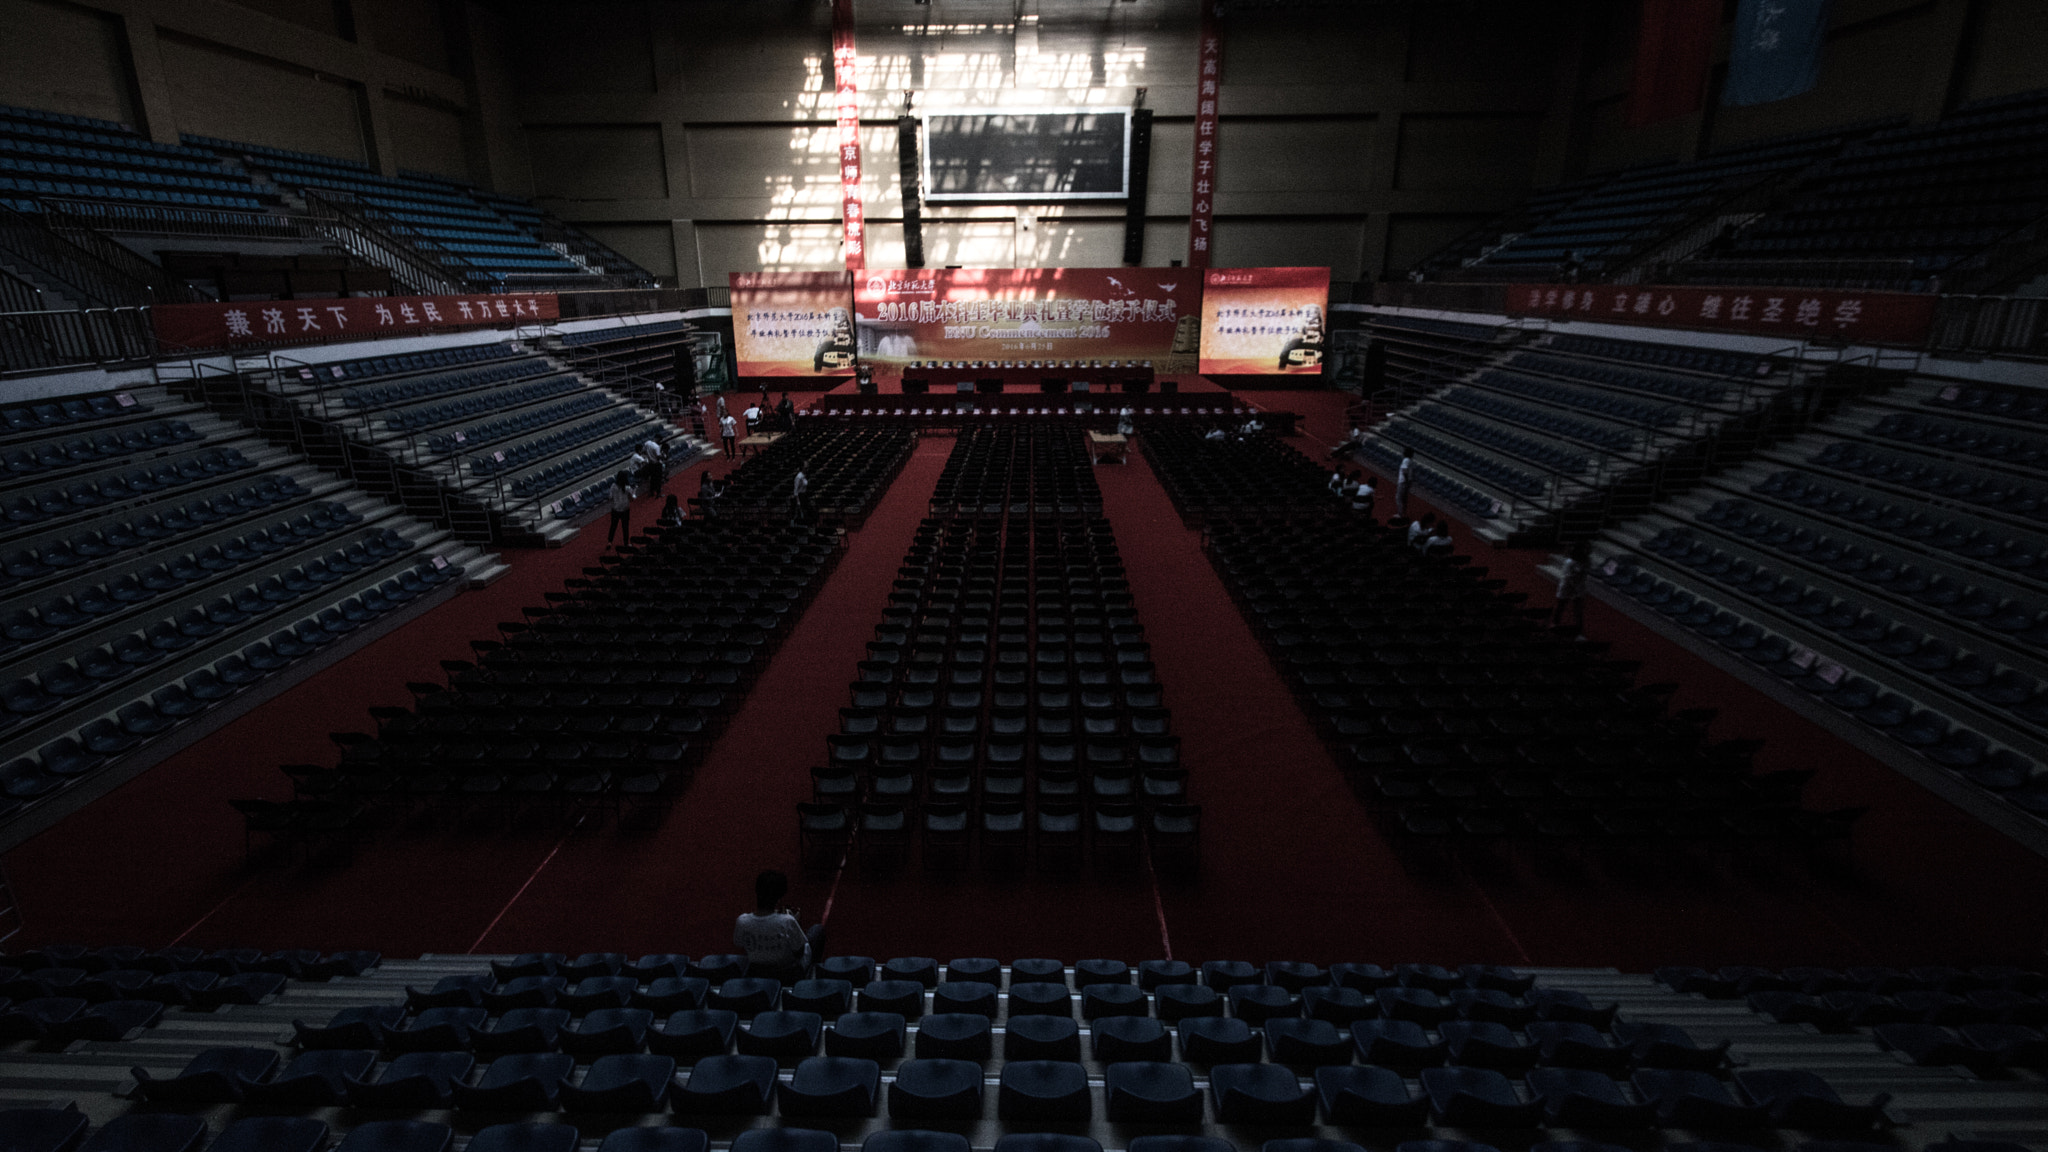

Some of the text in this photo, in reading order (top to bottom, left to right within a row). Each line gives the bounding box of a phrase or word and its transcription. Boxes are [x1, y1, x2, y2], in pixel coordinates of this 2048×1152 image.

[224, 299, 540, 338] 兼济天下 为生民 开万世太平
[877, 299, 1177, 323] 2016届本科生毕业典礼暨学位授予仪式
[1699, 294, 1863, 329] 继往圣绝学
[979, 325, 1077, 339] Commencement
[1079, 325, 1111, 339] 2016
